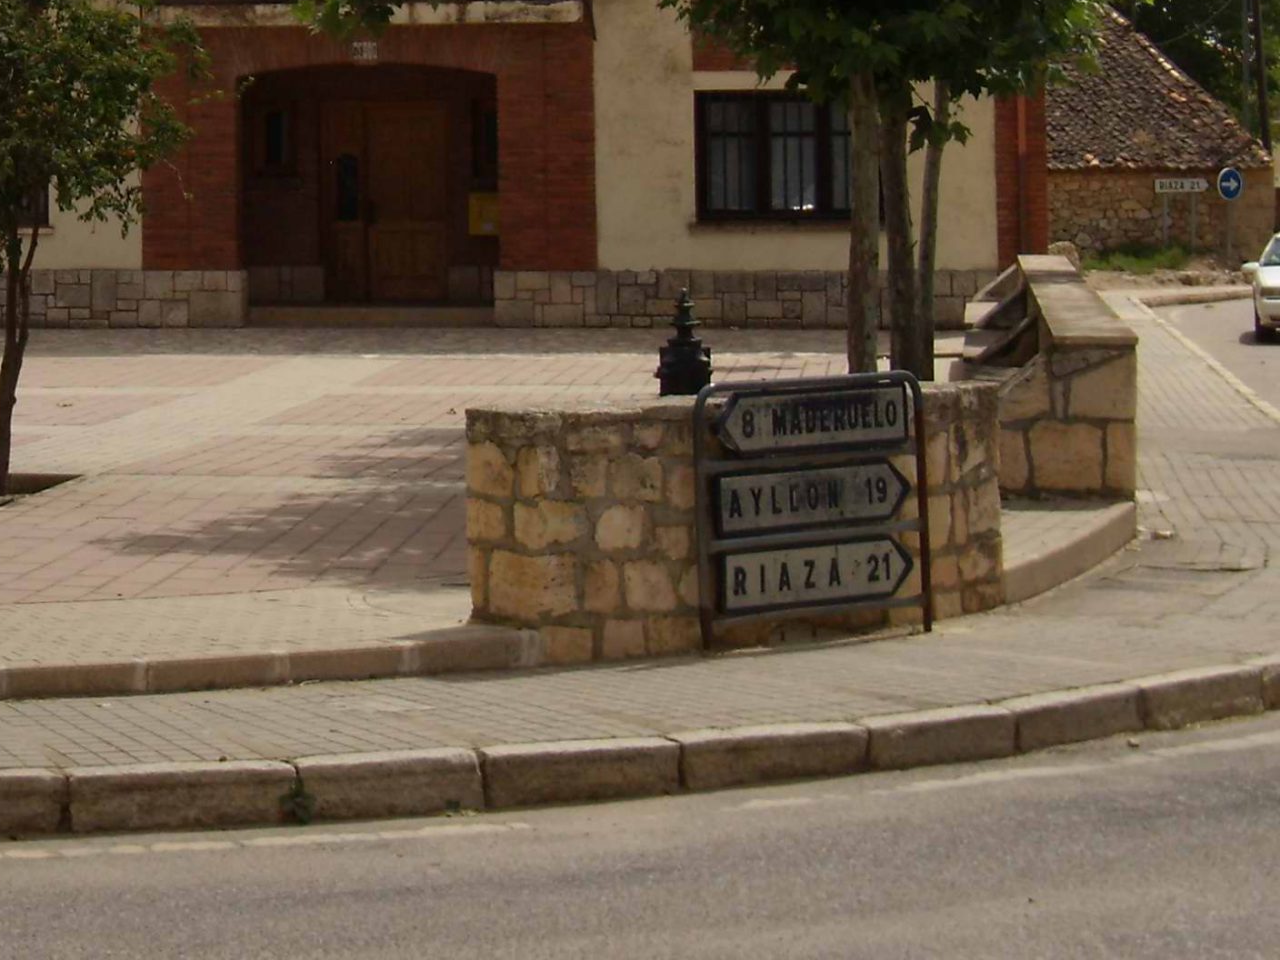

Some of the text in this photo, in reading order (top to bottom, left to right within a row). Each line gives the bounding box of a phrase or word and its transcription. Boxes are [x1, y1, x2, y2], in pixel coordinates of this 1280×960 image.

[741, 400, 897, 438] 8 MADERUELO
[729, 477, 887, 519] AYLLON 19
[732, 553, 891, 596] RIAZA 21
